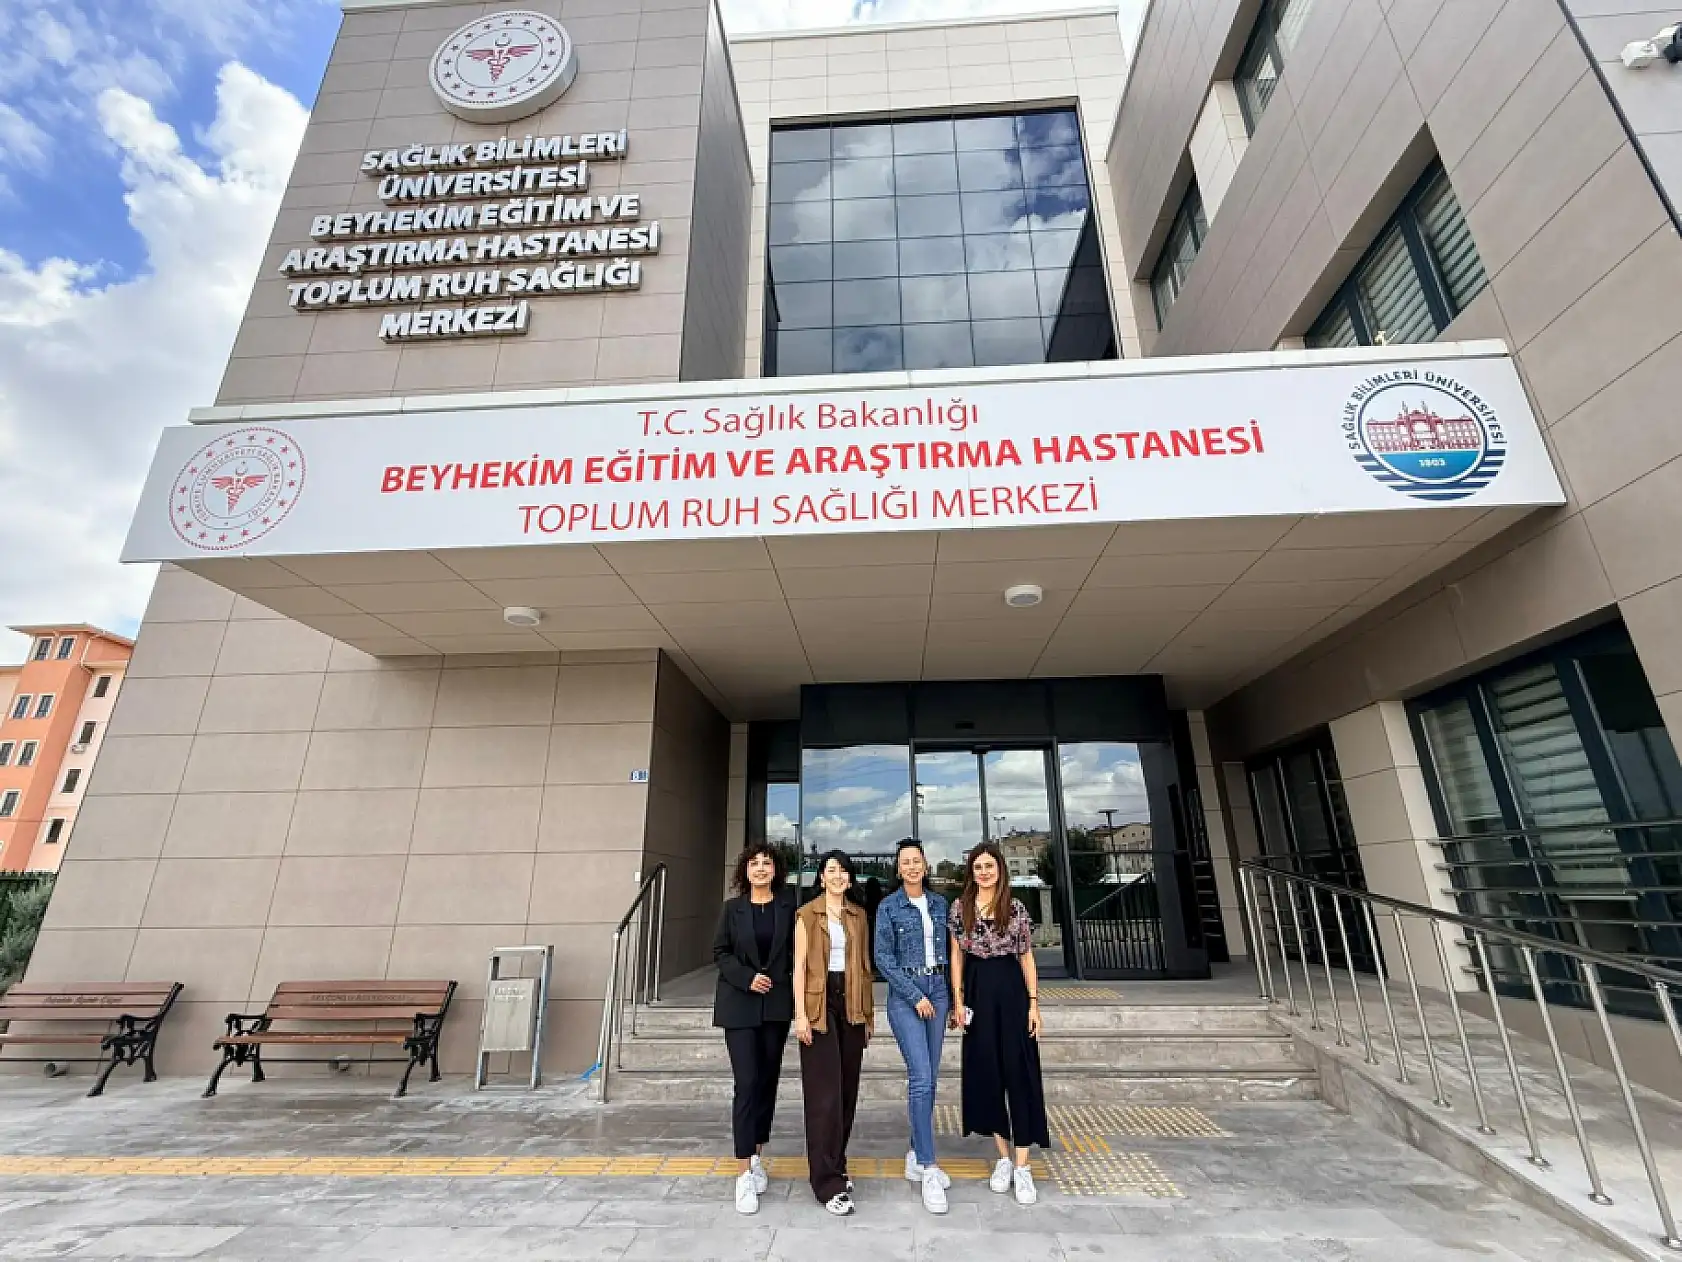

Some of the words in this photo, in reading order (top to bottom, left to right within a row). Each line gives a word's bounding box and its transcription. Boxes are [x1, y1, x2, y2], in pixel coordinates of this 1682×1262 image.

[361, 143, 470, 174] SAĞLIK
[476, 129, 629, 162] BİLİMLERİ
[378, 160, 590, 201] ÜNİVERSİTESİ
[310, 203, 474, 239] BEYHEKİM
[480, 194, 595, 228] EĞİTİM
[595, 193, 641, 220] VE
[279, 238, 470, 275] ARAŞTIRMA
[475, 221, 661, 259] HASTANESİ
[287, 275, 422, 308] TOPLUM
[428, 270, 500, 298] RUH
[505, 259, 643, 292] SAĞLIĞI
[379, 301, 529, 339] MERKEZİ
[637, 410, 694, 437] T.C.
[703, 403, 806, 439] Sağlık
[818, 398, 979, 431] Bakanlığı
[1341, 402, 1360, 450] SAĞLIK
[1351, 369, 1418, 402] BİLİMLERİ
[380, 452, 574, 493] BEYHEKİM
[584, 446, 716, 484] EĞİTİM
[726, 447, 775, 478] VE
[785, 439, 1022, 479] ARAŞTIRMA
[1032, 419, 1265, 465] HASTANESİ
[518, 499, 670, 534] TOPLUM
[681, 496, 759, 527] RUH
[772, 485, 917, 525] SAĞLIĞI
[932, 476, 1099, 519] MERKEZİ
